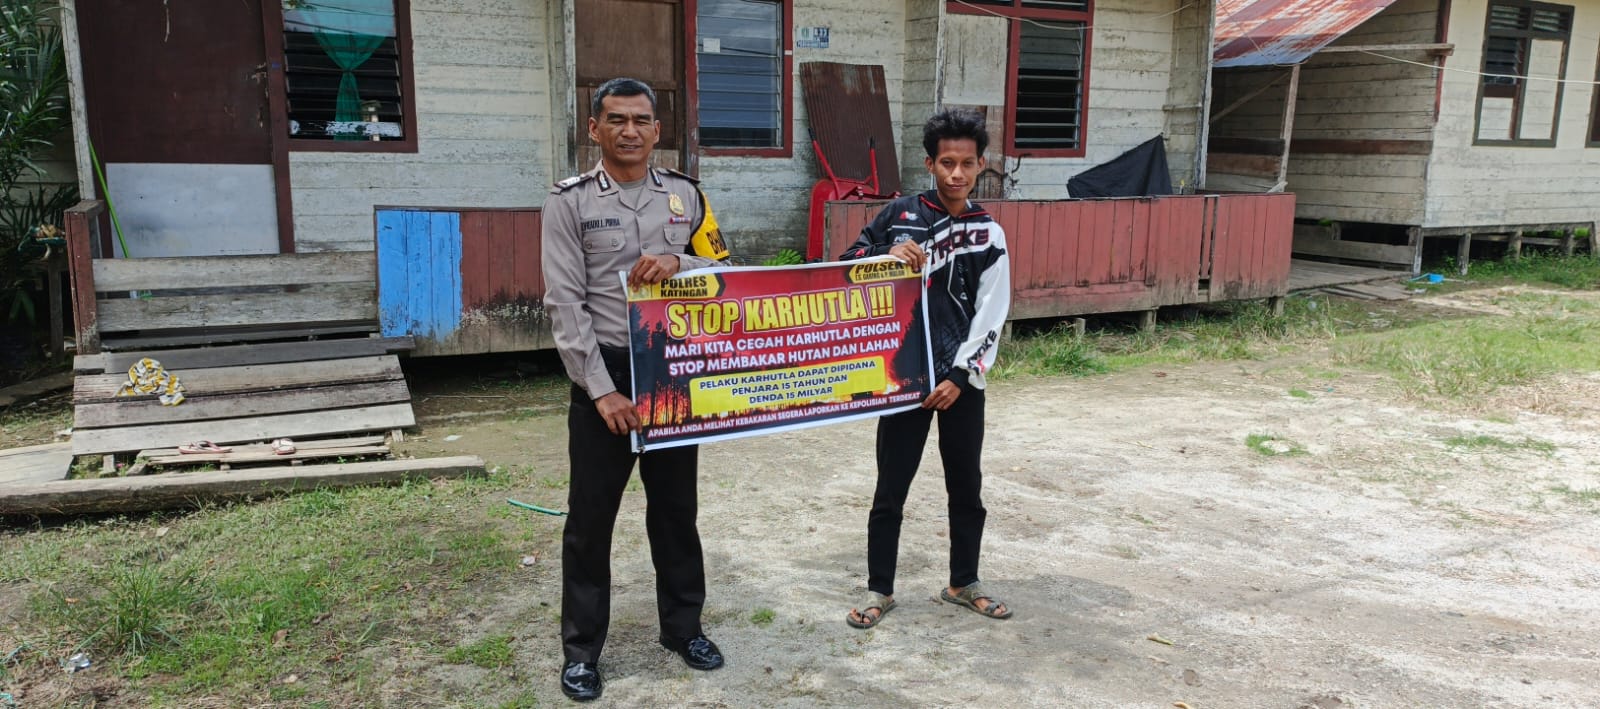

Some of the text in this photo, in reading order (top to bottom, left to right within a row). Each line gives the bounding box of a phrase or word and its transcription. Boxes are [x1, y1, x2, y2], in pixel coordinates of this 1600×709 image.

[929, 228, 989, 266] TROKE
[661, 275, 707, 289] POLRES
[661, 288, 708, 298] KATINGAN
[667, 284, 894, 340] STOP KARHUTLA !!!
[665, 321, 901, 359] MARI KITA CEGAH KARHUTLA DENGAN
[669, 337, 900, 376] STOP MEMBAKAR HUTAN DAN LAHAN
[700, 360, 876, 390] PELAKU KARHUTLA DAPAT DIPIDANA
[732, 374, 848, 396] PENJARA 15 TAHUN DAN
[749, 386, 833, 405] DENDA 15 MILYAR
[648, 392, 920, 438] APABILA ANDA MELIHAT KEBAKARAN SEGERA LAPORKAN KE KEPOLISIAN TERDEKAT
